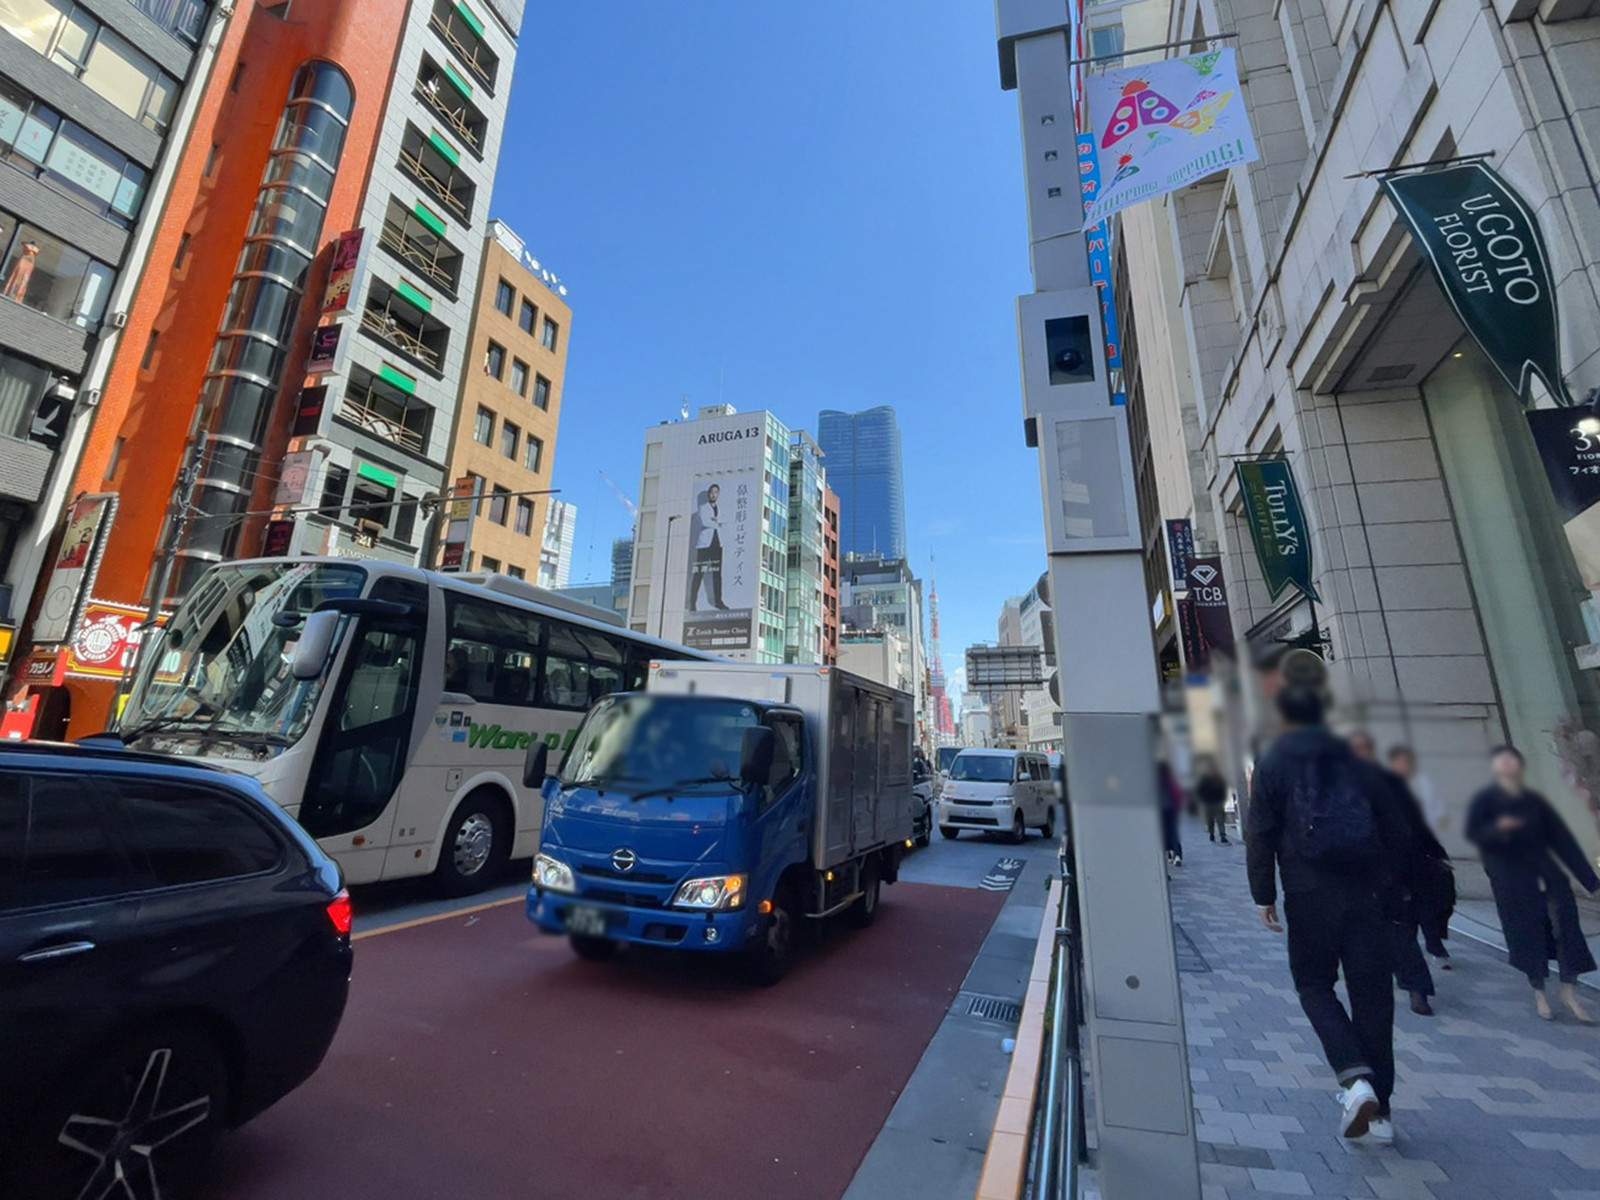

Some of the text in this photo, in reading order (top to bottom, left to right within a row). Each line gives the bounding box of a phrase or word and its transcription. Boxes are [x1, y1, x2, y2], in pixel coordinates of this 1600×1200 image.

[1433, 213, 1494, 293] FLORIST
[1461, 193, 1540, 305] U.GOTO
[698, 426, 760, 445] ARUGA 13
[732, 484, 748, 587] 鼻整形はゼティス
[1253, 495, 1272, 539] COFFEE
[1264, 479, 1299, 556] TULLY'S
[1192, 586, 1223, 602] TCB
